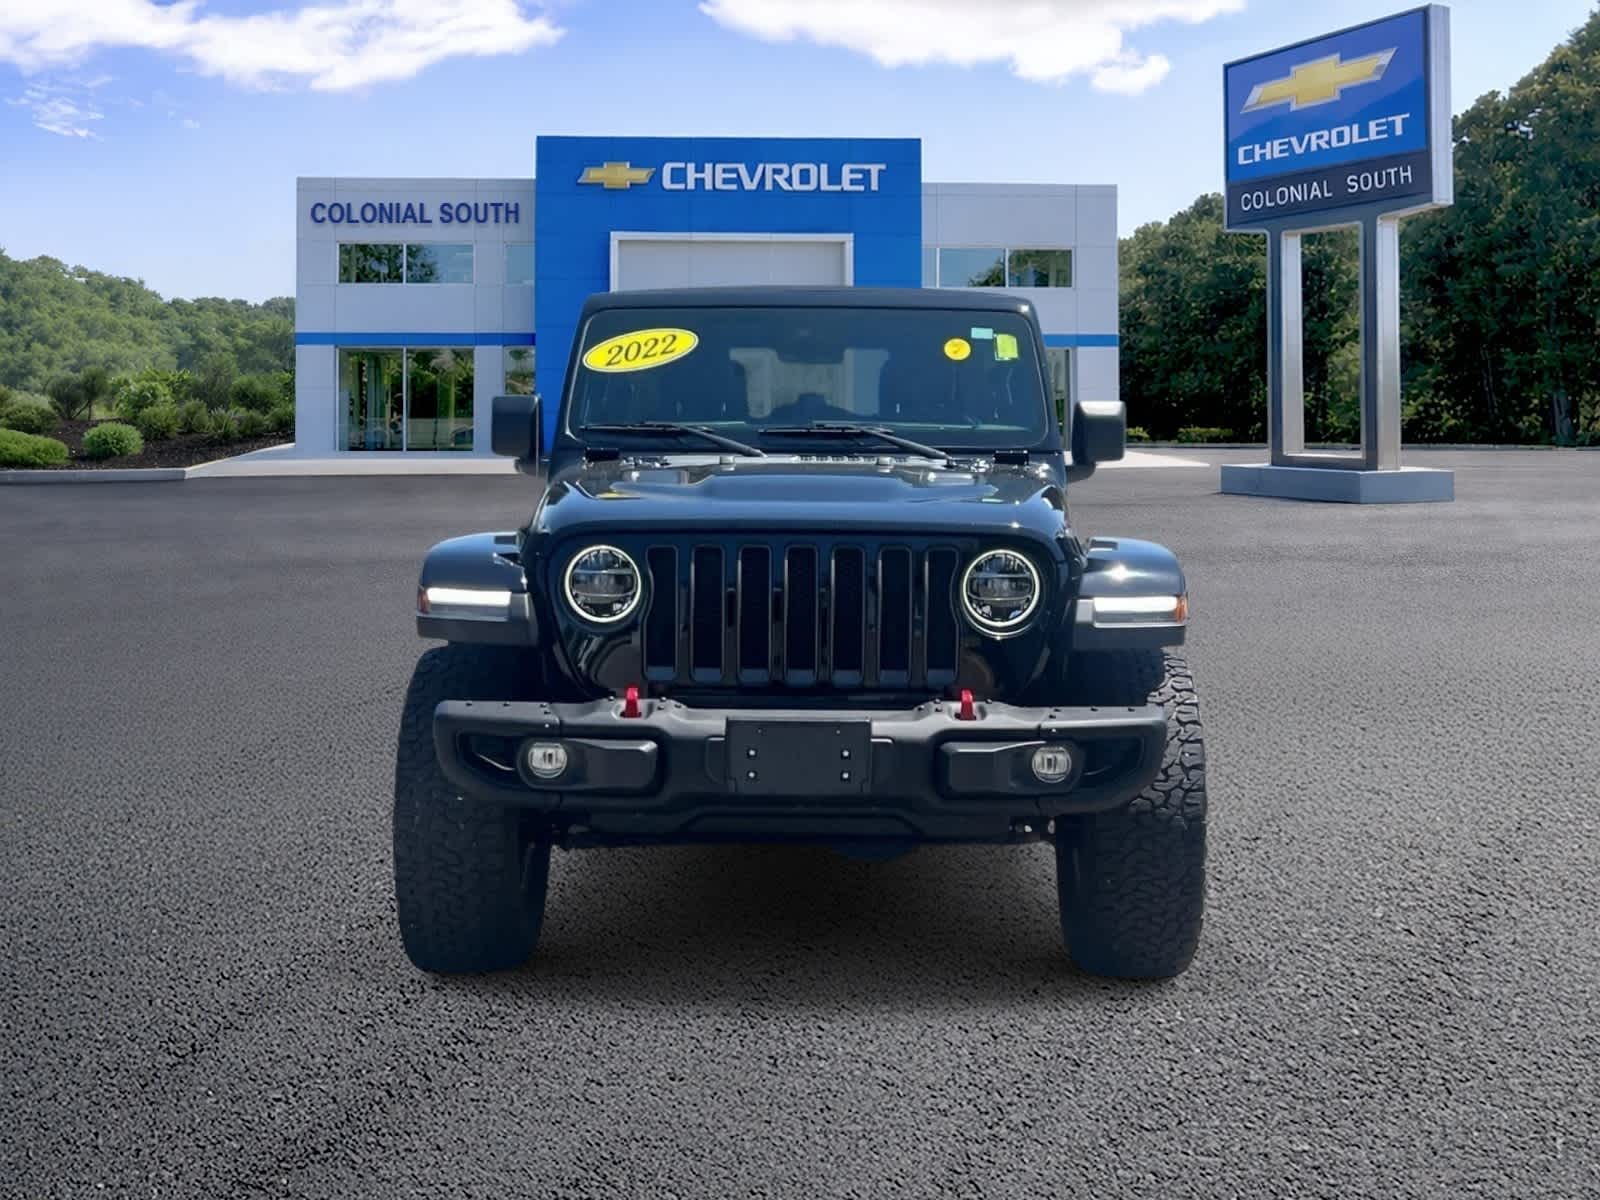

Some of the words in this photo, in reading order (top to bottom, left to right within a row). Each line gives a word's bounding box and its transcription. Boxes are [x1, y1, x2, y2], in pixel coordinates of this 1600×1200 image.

[1237, 113, 1410, 165] CHEVROLET
[662, 162, 887, 192] CHEVROLET
[1240, 179, 1333, 211] COLONIAL
[1346, 165, 1412, 193] SOUTH
[310, 202, 433, 225] COLONIAL
[439, 202, 520, 225] SOUTH
[605, 334, 677, 367] 2022
